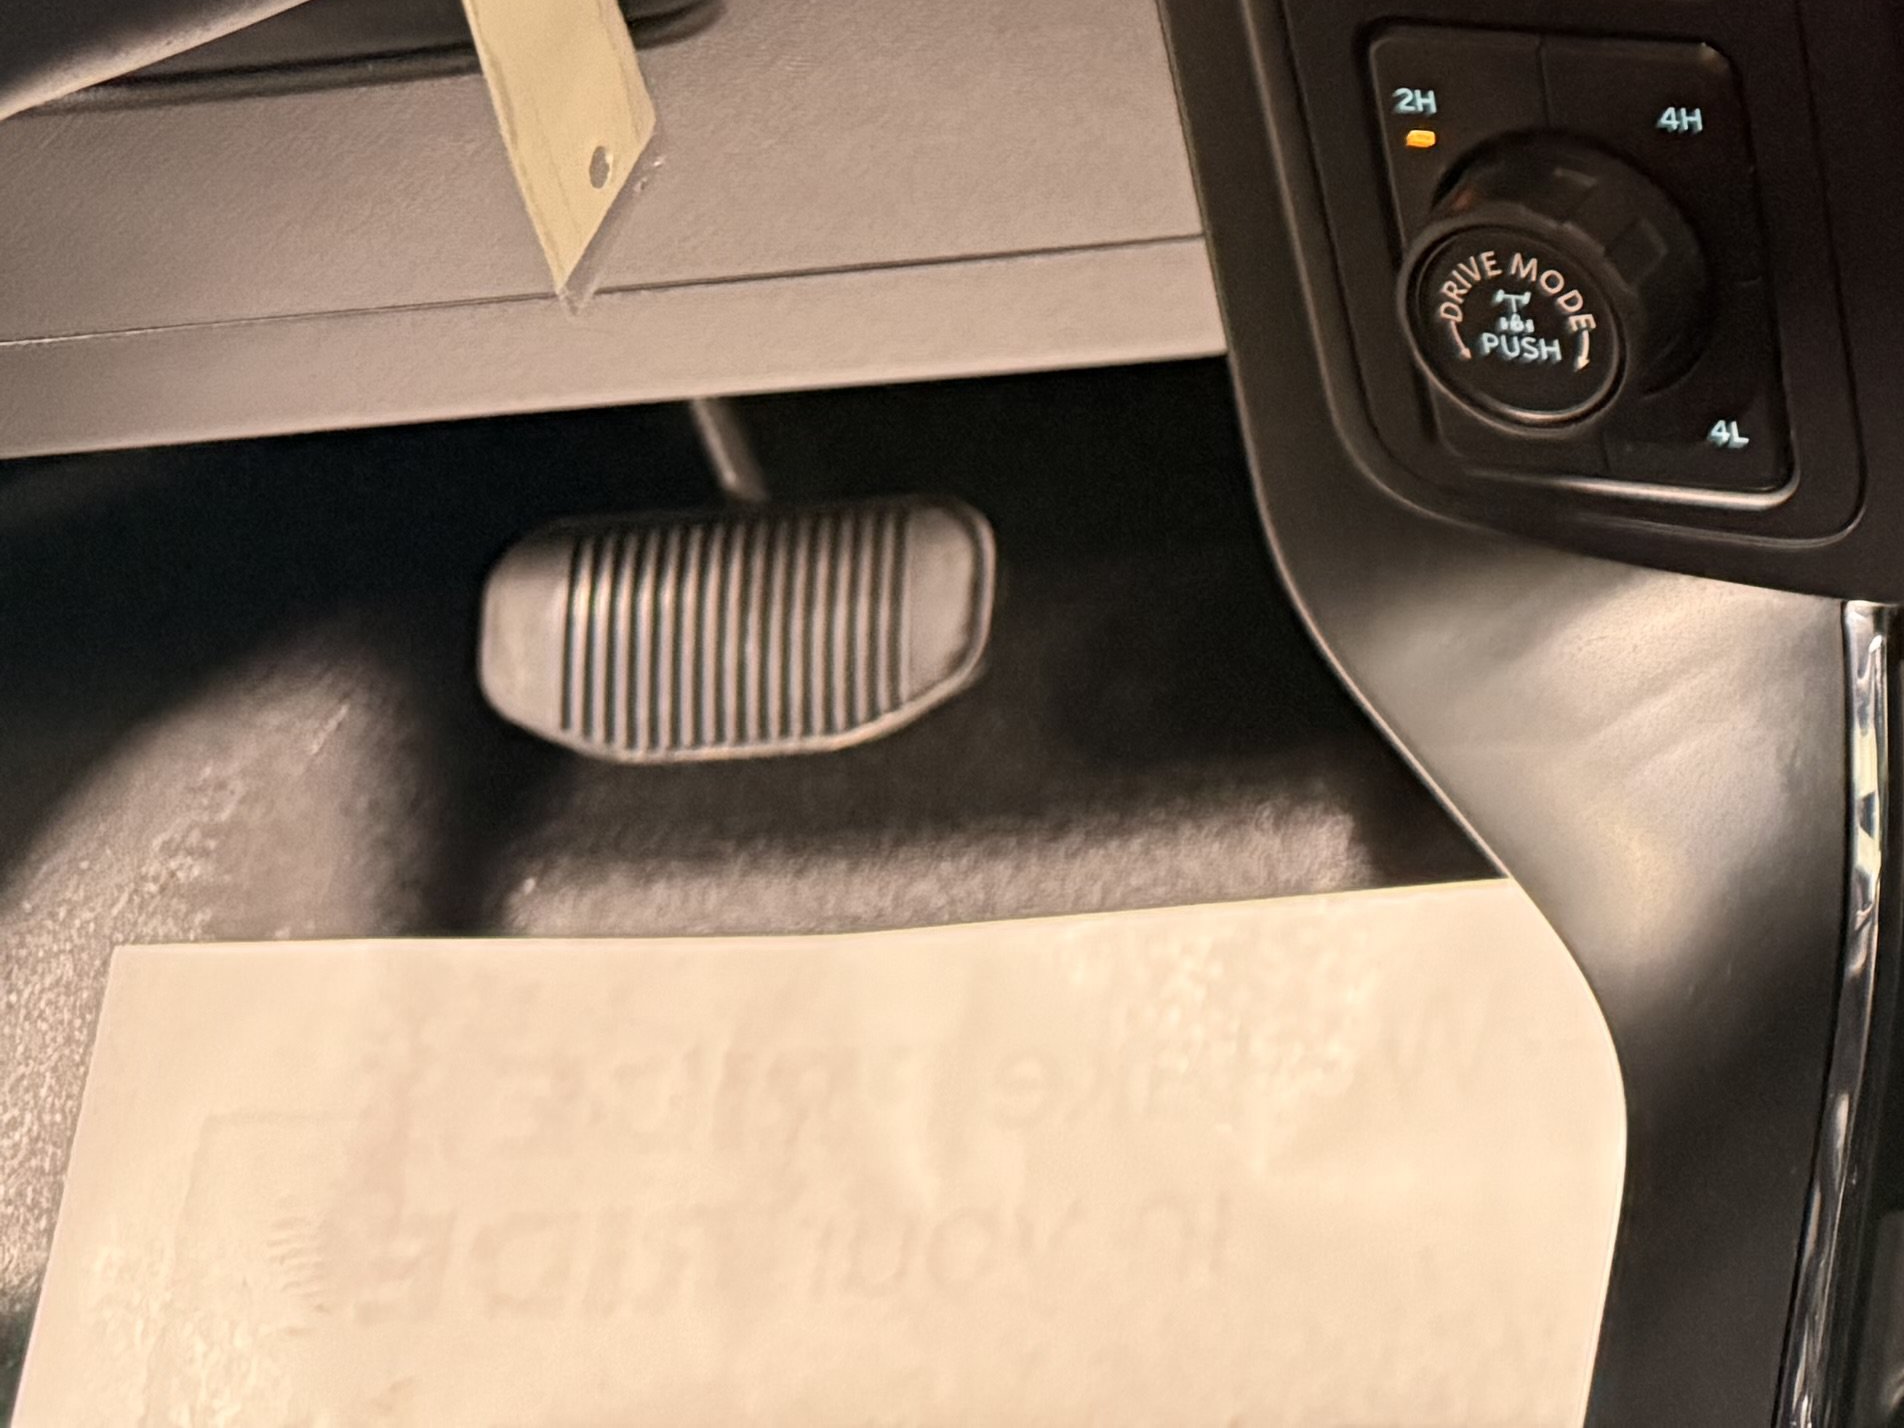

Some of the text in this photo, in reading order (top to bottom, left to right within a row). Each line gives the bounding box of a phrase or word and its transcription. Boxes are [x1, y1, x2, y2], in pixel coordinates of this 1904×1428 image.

[1393, 87, 1437, 115] 2H
[1656, 106, 1704, 133] 4H
[1439, 250, 1597, 331] DRIVE MODE
[1480, 331, 1563, 362] PUSH
[1707, 419, 1750, 449] 4L
